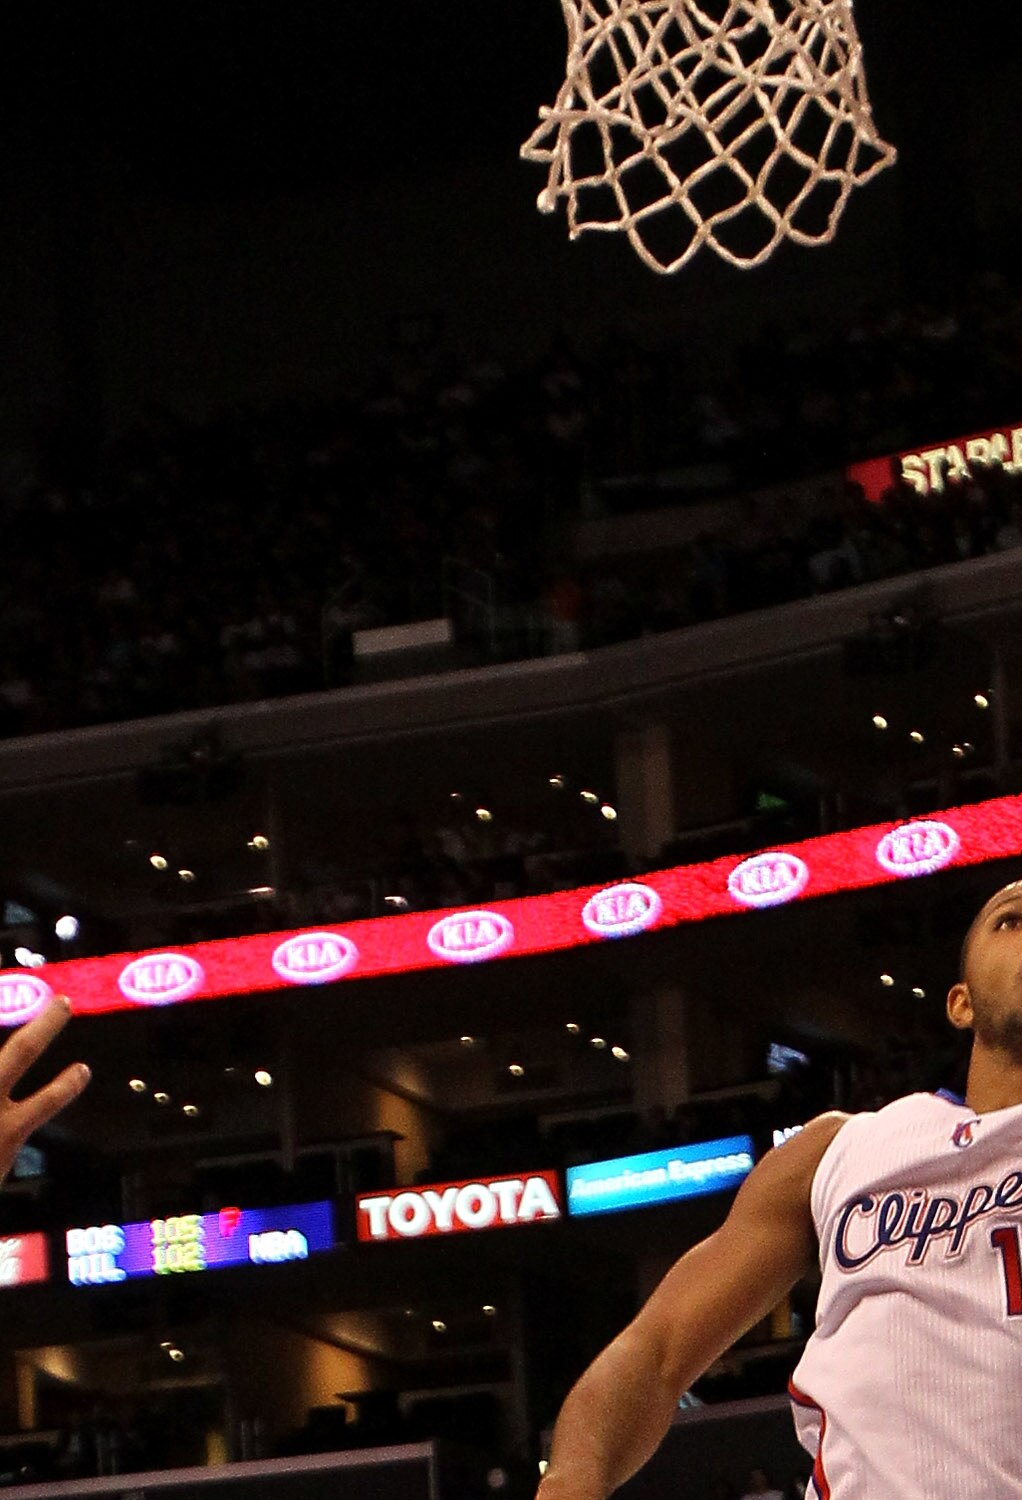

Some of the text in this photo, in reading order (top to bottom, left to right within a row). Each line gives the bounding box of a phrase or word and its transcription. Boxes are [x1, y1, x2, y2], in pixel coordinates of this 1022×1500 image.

[890, 830, 944, 862] KIA
[738, 862, 793, 895] KIA
[596, 893, 649, 925] KIA
[441, 920, 499, 949] KIA
[285, 940, 342, 968] KIA
[133, 964, 185, 990] KIA
[569, 1151, 753, 1200] American Express
[358, 1175, 561, 1239] TOYOTA
